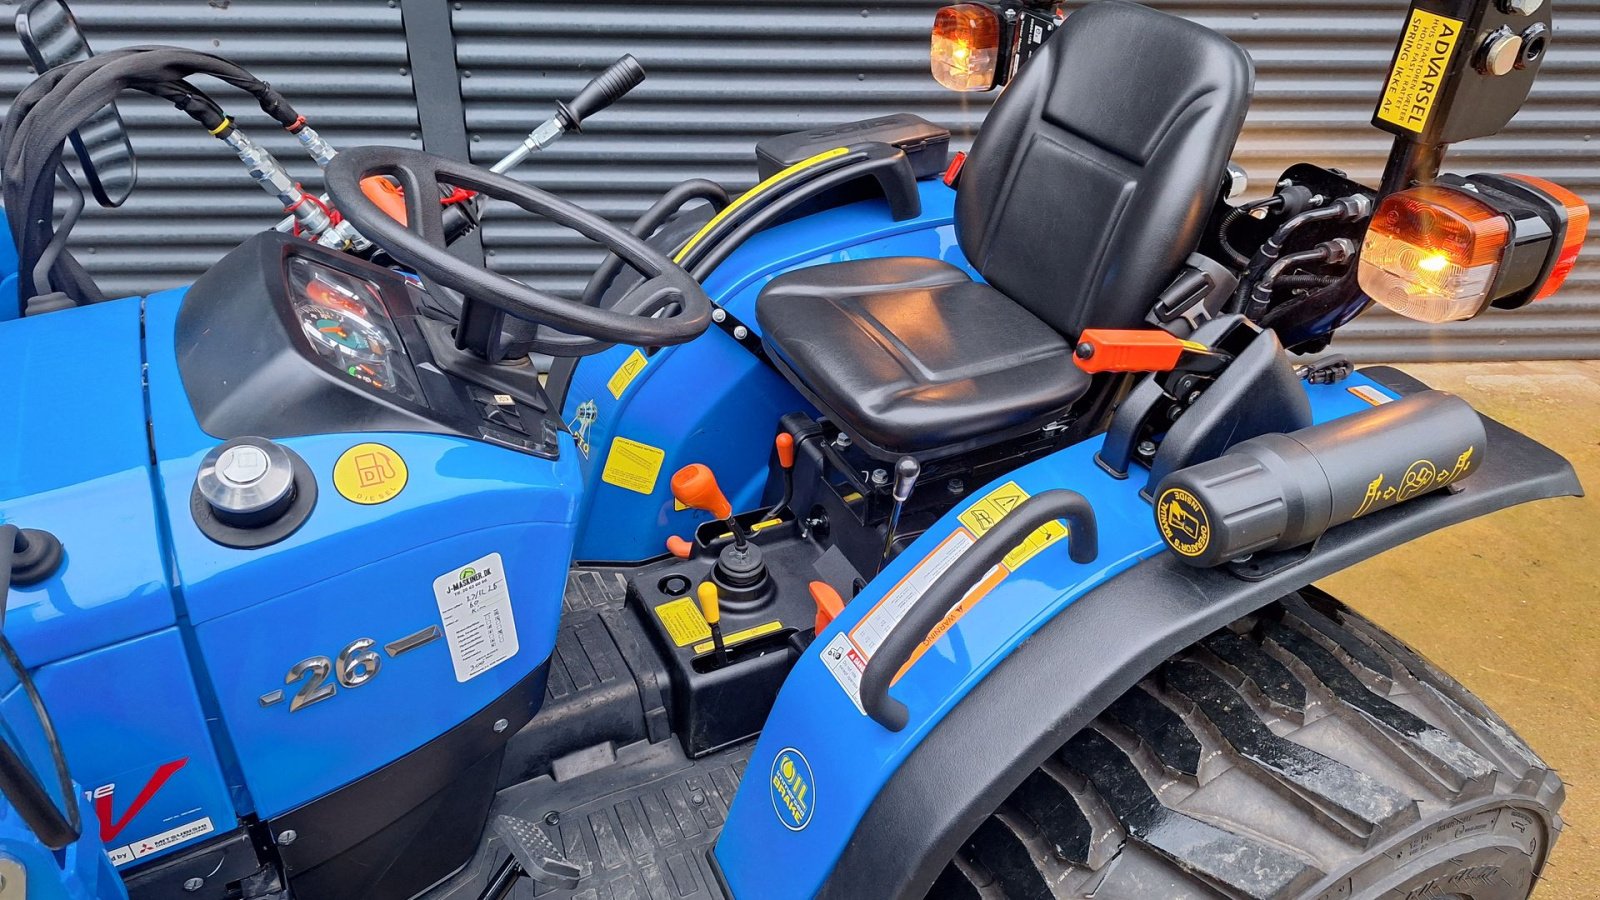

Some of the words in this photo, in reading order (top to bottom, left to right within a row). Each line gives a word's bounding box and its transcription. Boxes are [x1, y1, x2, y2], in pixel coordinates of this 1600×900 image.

[1400, 17, 1422, 61] SPRING
[1417, 27, 1430, 49] HOLD
[1429, 19, 1440, 38] HVIS
[1407, 23, 1455, 124] ADVARSEL
[1408, 53, 1419, 71] FAST
[1409, 42, 1432, 89] TRAKTOREN
[1389, 67, 1405, 93] IKKE
[1383, 99, 1393, 114] AF
[1396, 81, 1408, 110] RATTET
[356, 487, 396, 501] DIESEL
[1174, 491, 1200, 512] INSIDE
[1174, 525, 1208, 553] OPERATOR'S
[446, 568, 491, 594] J-MASKINER.DK
[922, 614, 957, 647] WARNING
[780, 755, 808, 810] OIL
[773, 775, 802, 825] BRAKE
[155, 824, 207, 846] MITSUBISHI
[117, 849, 127, 860] by
